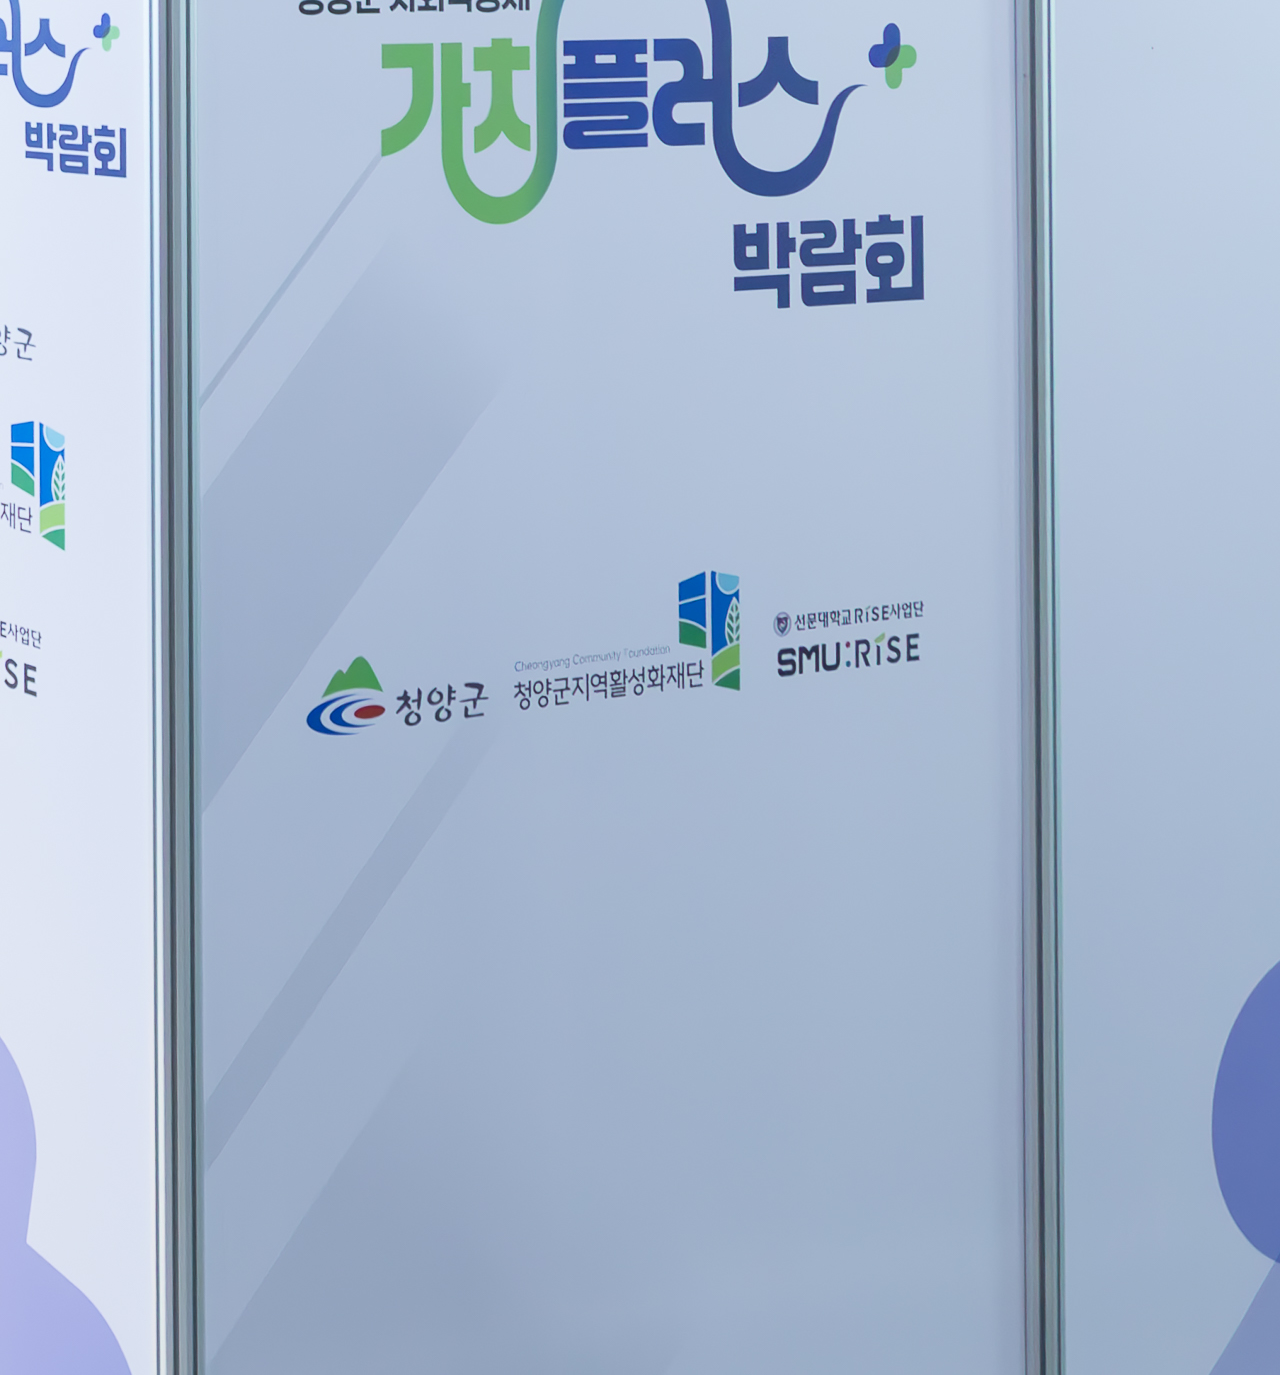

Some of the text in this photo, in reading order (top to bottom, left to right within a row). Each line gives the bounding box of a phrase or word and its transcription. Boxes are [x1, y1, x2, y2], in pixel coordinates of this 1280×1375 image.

[25, 121, 127, 178] 박람회
[733, 214, 925, 309] 박람회
[395, 681, 489, 727] 청양군
[513, 659, 705, 711] 청양군지역활성화재단
